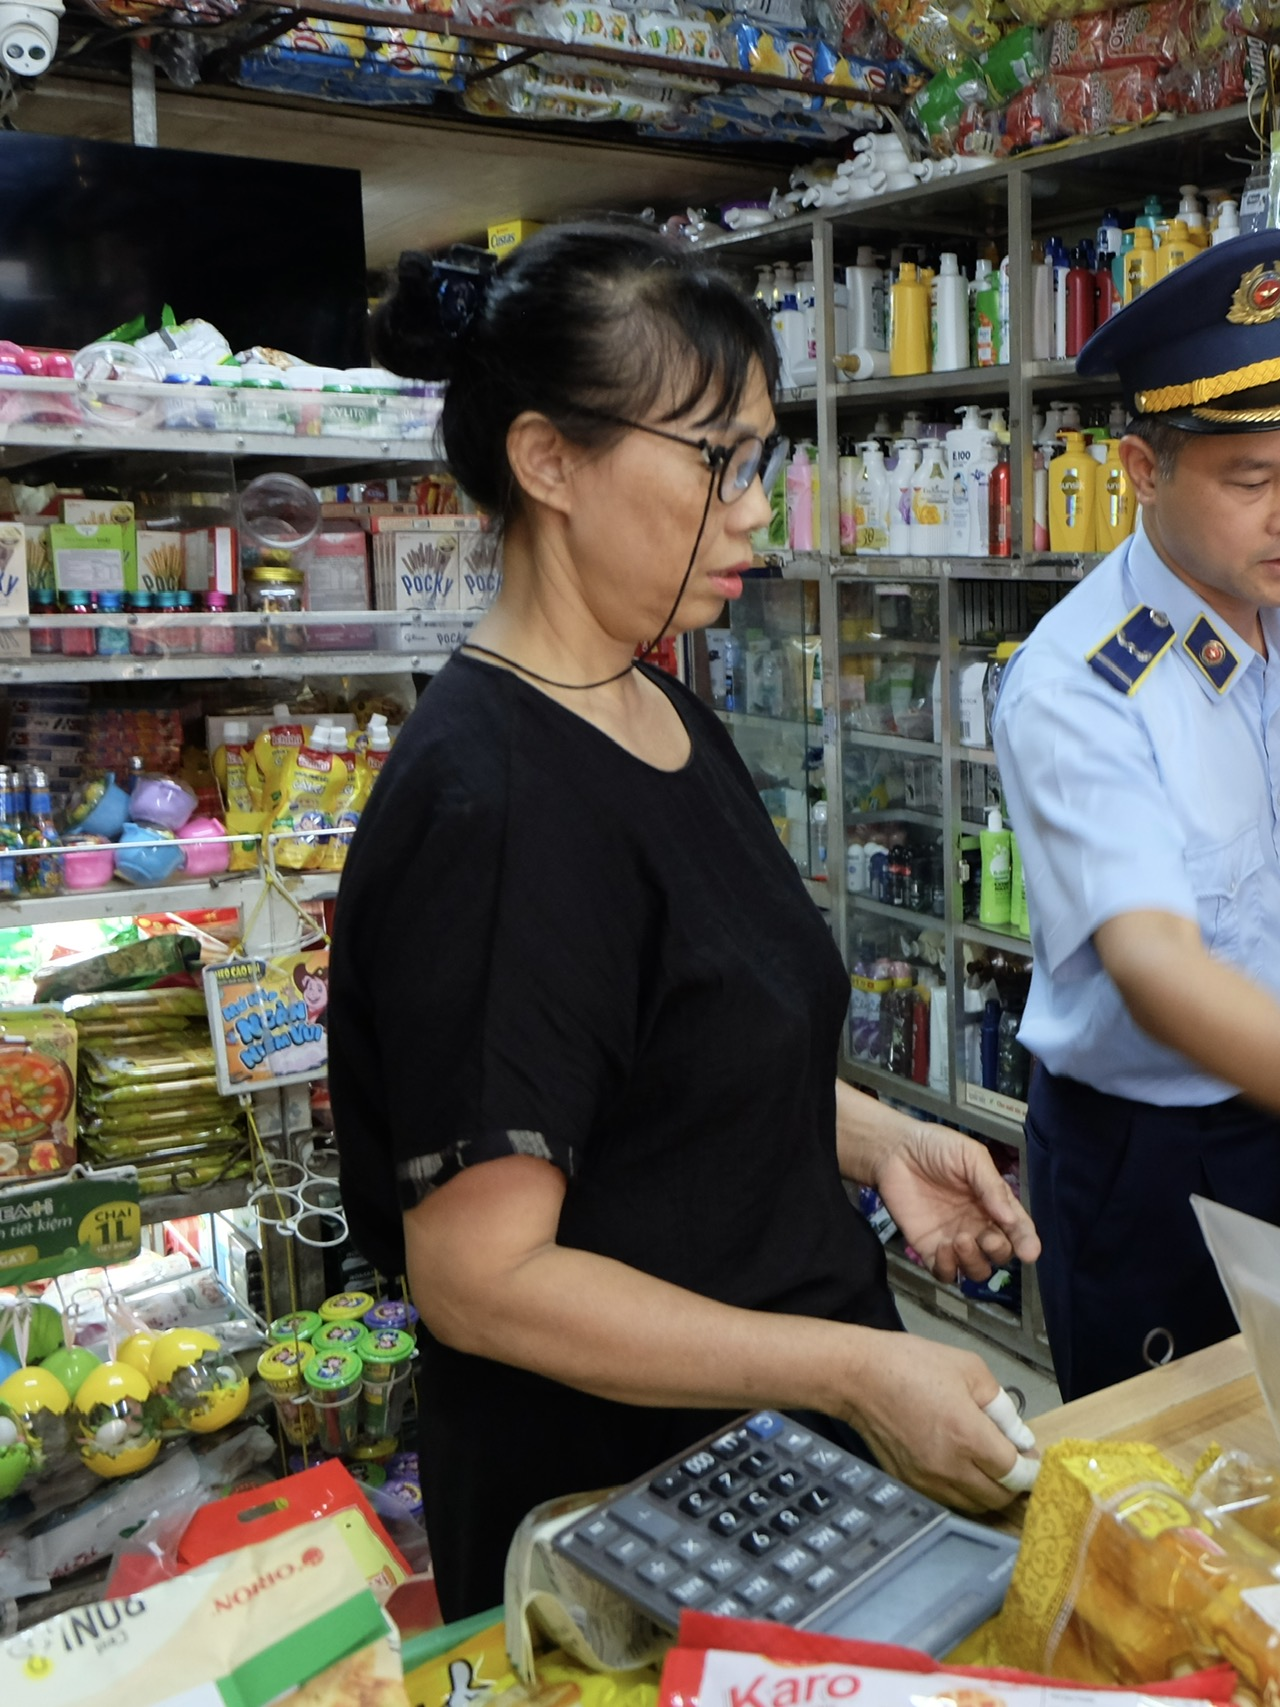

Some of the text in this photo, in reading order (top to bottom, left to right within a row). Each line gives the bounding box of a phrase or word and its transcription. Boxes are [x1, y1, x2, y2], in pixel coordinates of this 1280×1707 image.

[464, 573, 503, 596] POC
[240, 1031, 292, 1070] NIM
[95, 1207, 132, 1222] CHAI
[95, 1220, 133, 1245] 1L
[213, 1562, 296, 1616] ORION
[729, 1672, 863, 1707] Karo
